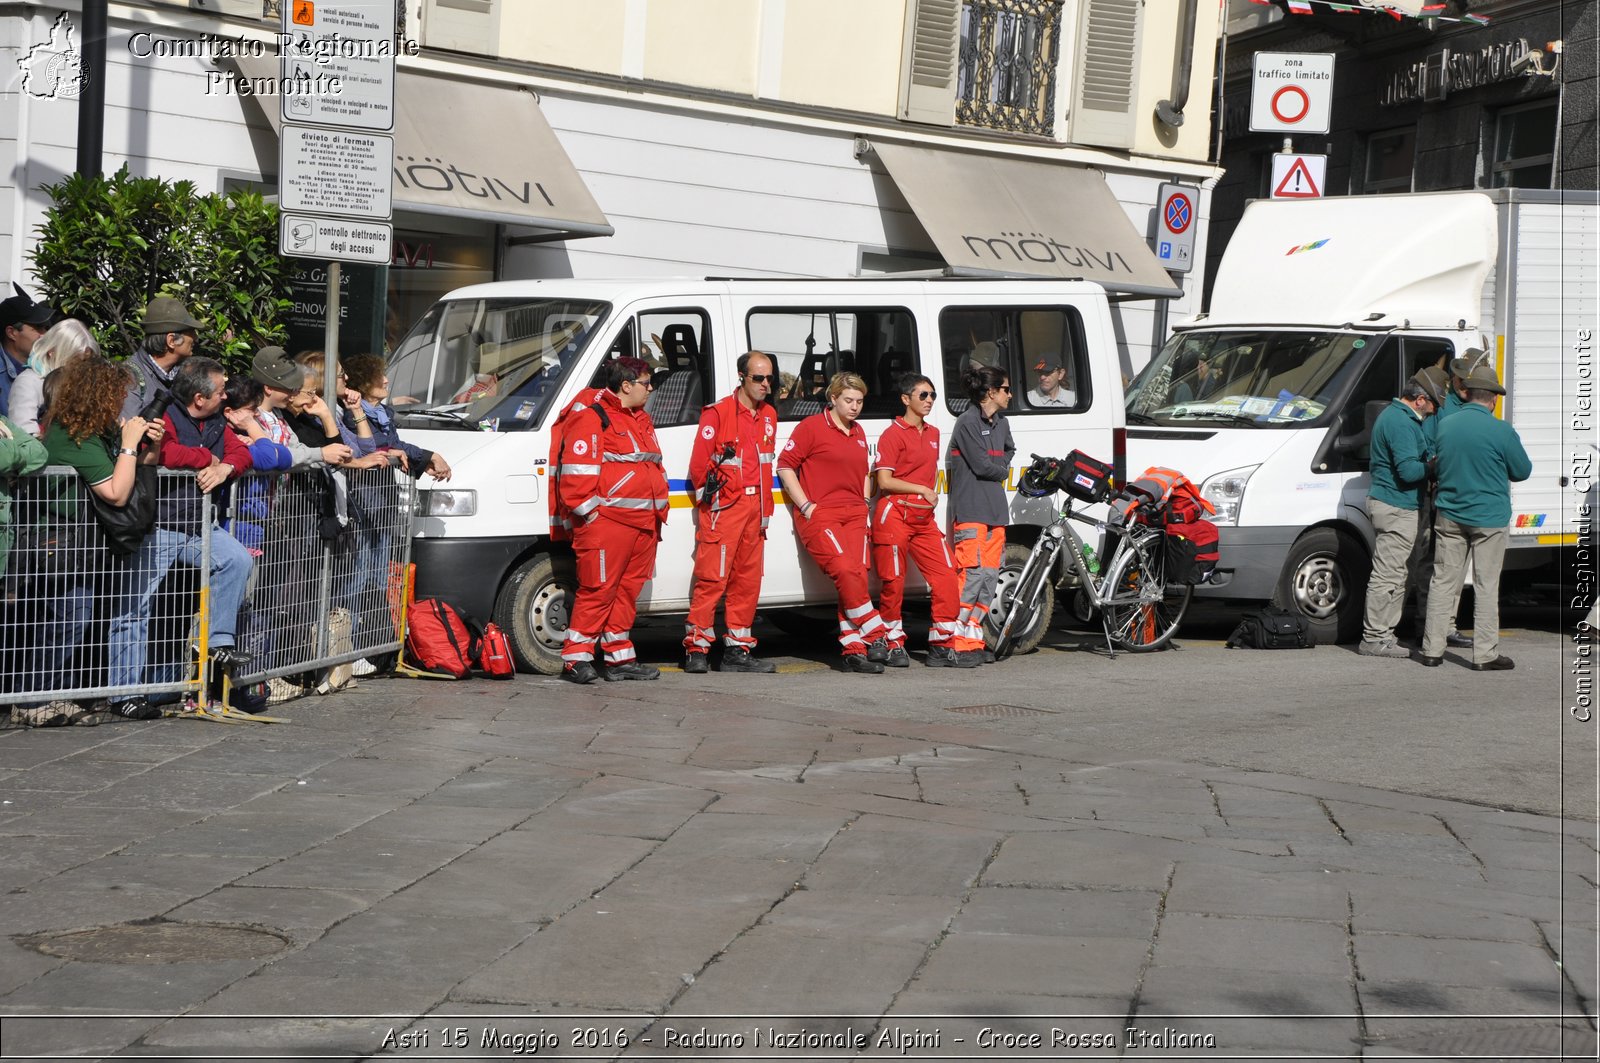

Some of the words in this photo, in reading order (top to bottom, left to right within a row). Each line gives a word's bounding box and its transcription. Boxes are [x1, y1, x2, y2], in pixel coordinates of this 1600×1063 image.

[339, 11, 360, 19] autorizzati
[1259, 70, 1291, 78] traffico
[1296, 71, 1330, 80] limitato
[301, 133, 329, 142] divieto
[344, 137, 375, 146] fermata
[319, 227, 348, 238] controllo
[352, 229, 386, 241] elettronico
[330, 241, 346, 253] degli
[350, 244, 374, 254] accessi
[1162, 244, 1169, 256] P
